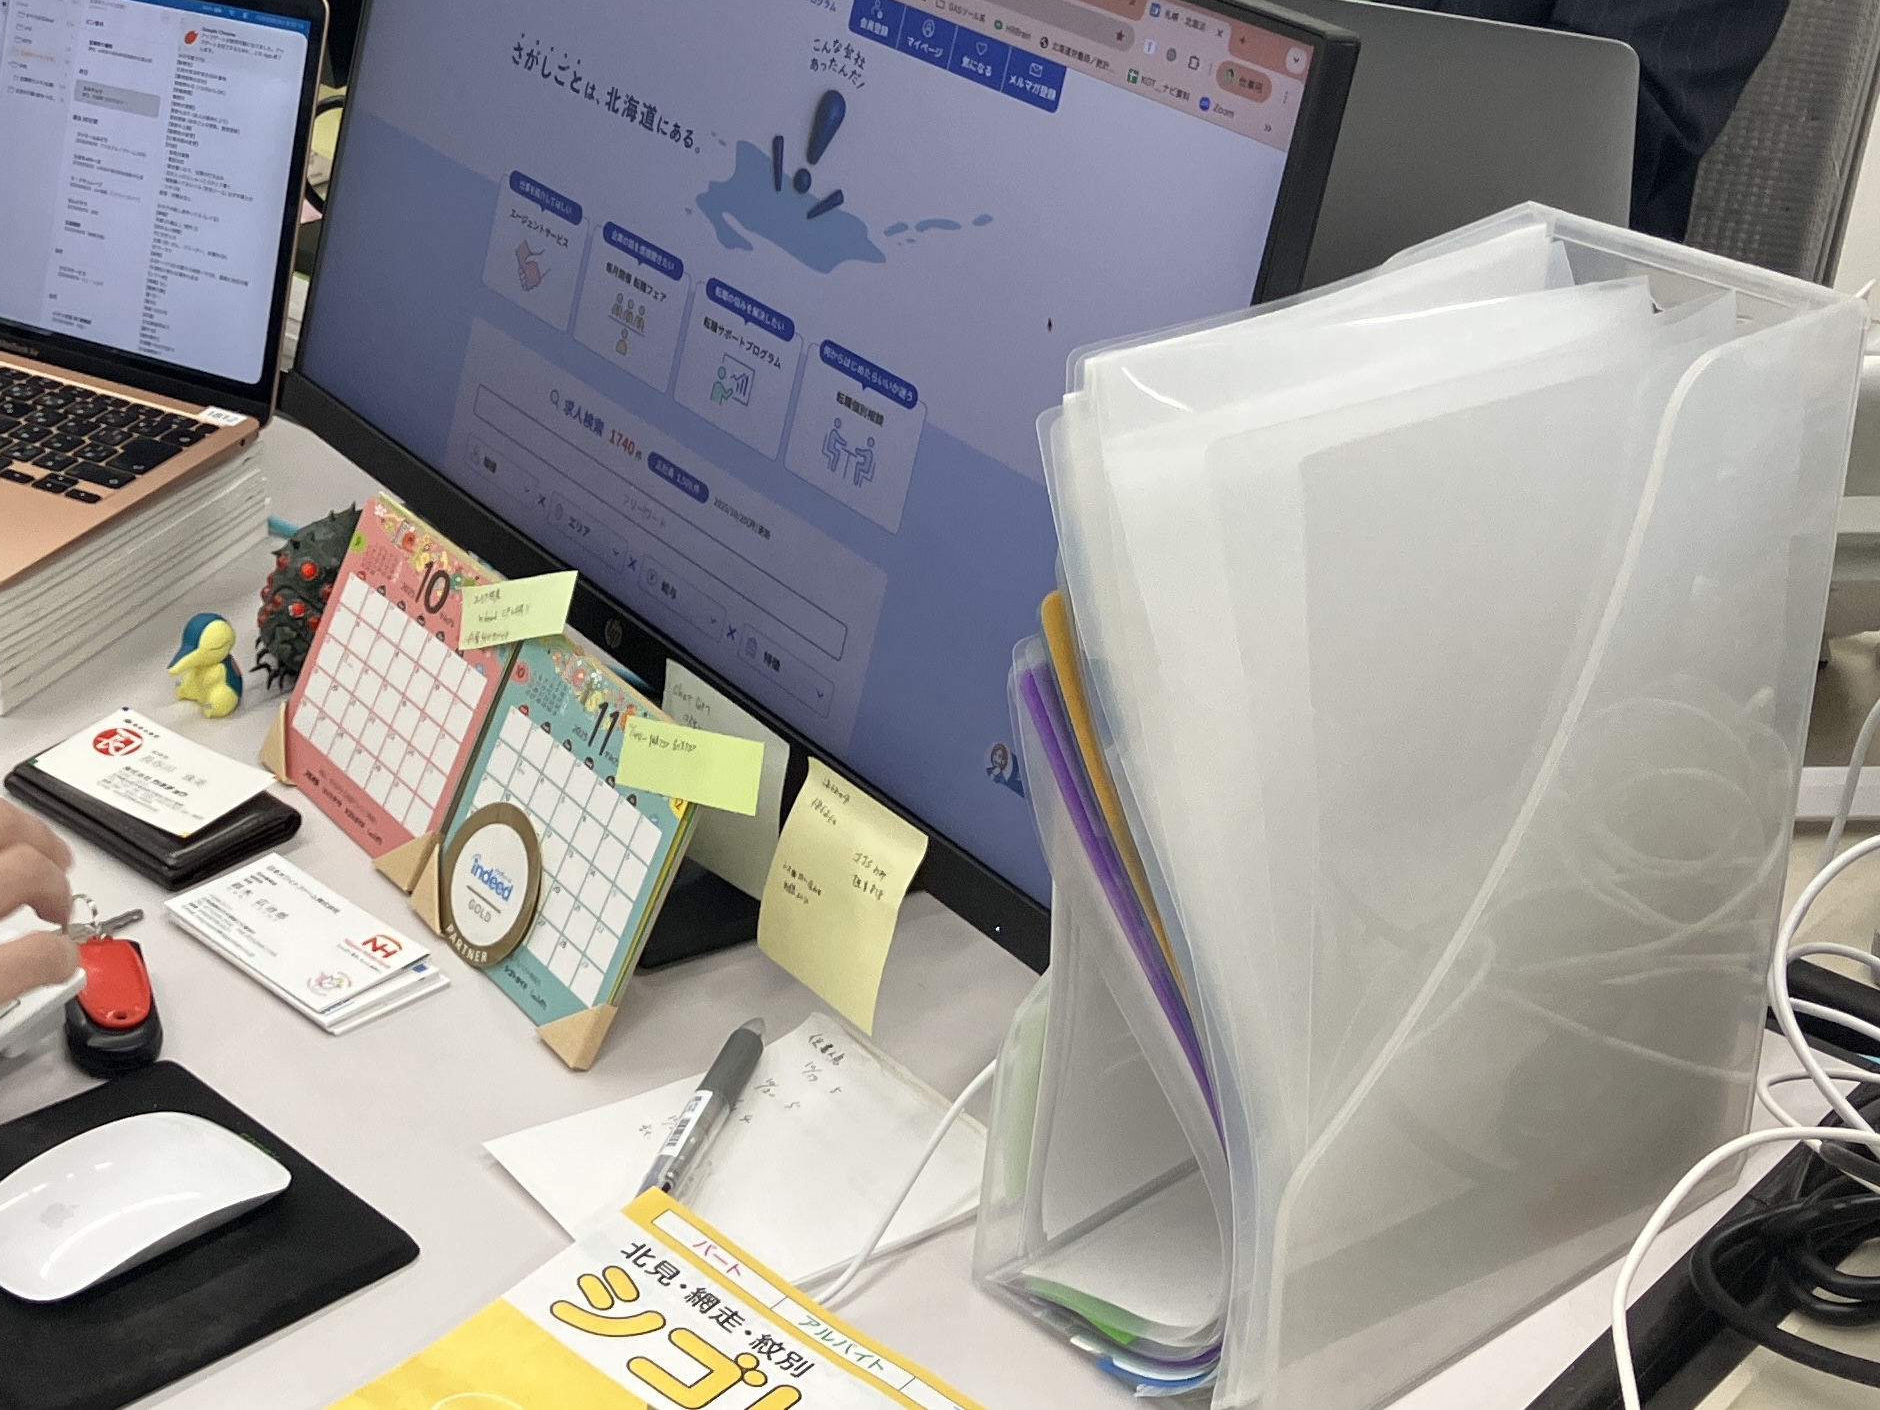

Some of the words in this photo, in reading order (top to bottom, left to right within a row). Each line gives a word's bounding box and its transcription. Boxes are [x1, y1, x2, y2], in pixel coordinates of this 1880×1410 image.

[860, 16, 889, 38] 会員登録
[907, 35, 944, 58] マイページ
[812, 38, 867, 71] こんな会社
[961, 56, 993, 77] 気になる
[511, 34, 701, 154] さがしごとは、北海道にある。
[1009, 73, 1057, 102] メルマガ登録
[1213, 103, 1235, 118] Zoom
[510, 208, 569, 248] エージェントサービス
[633, 277, 667, 302] 転職フェア
[703, 316, 781, 369] 転職サポートプログラム
[563, 398, 605, 438] 求人検索
[567, 517, 591, 537] エリア
[415, 560, 451, 614] 10
[587, 701, 620, 756] 11
[470, 857, 514, 902] indeed
[468, 899, 492, 923] GOLD
[362, 936, 398, 959] NH
[445, 924, 489, 963] PARTNER
[692, 1239, 742, 1278] パート
[620, 1241, 816, 1379] 北見・網走・紋別
[797, 1314, 886, 1372] アルバイト
